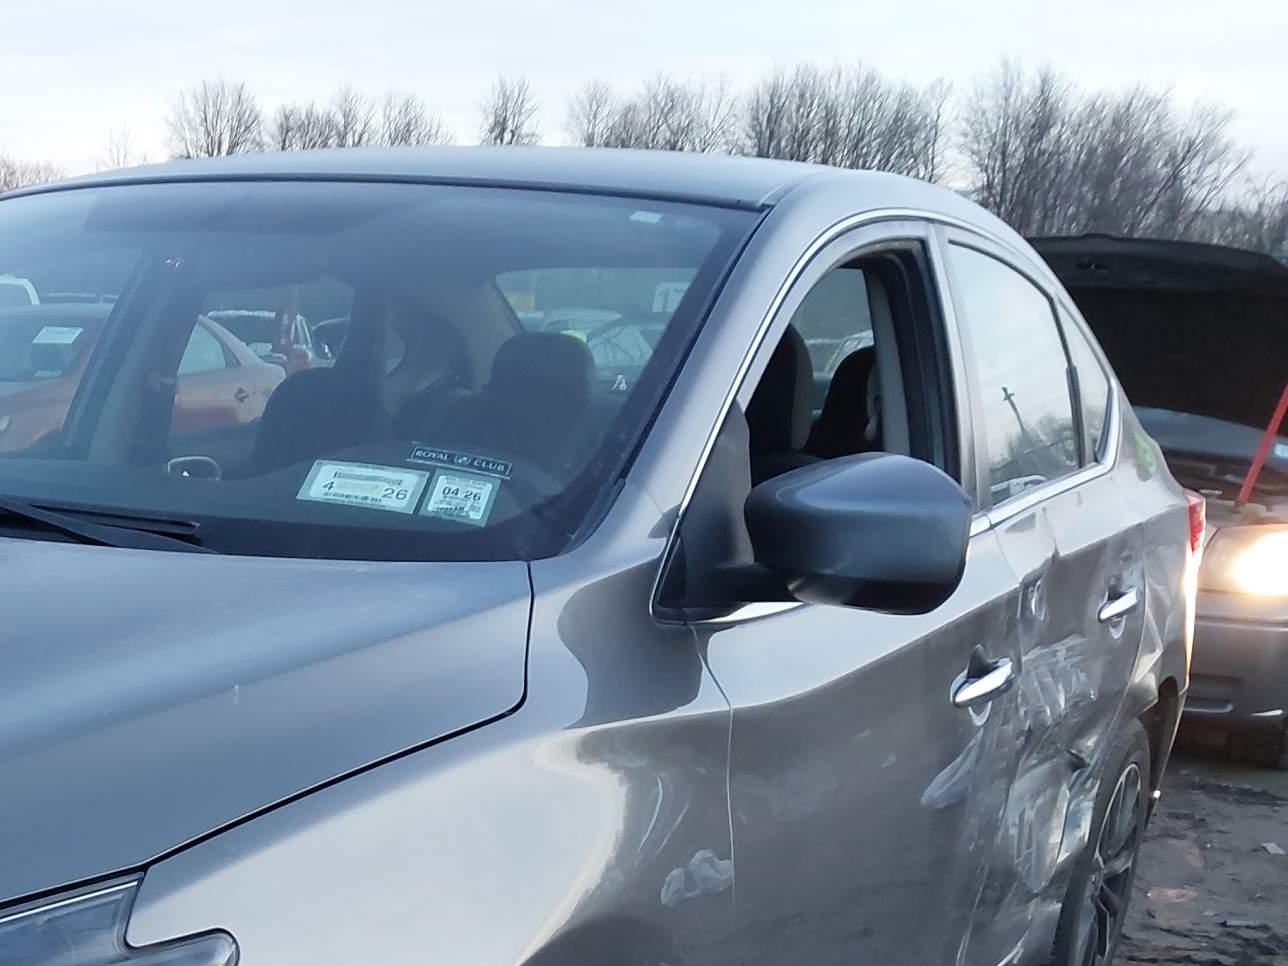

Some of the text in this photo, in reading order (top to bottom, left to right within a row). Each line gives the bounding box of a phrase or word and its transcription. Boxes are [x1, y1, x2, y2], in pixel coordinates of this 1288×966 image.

[415, 449, 506, 472] ROYAL CLUB
[322, 480, 334, 491] 4
[382, 487, 409, 501] 26
[442, 486, 481, 501] 04 26
